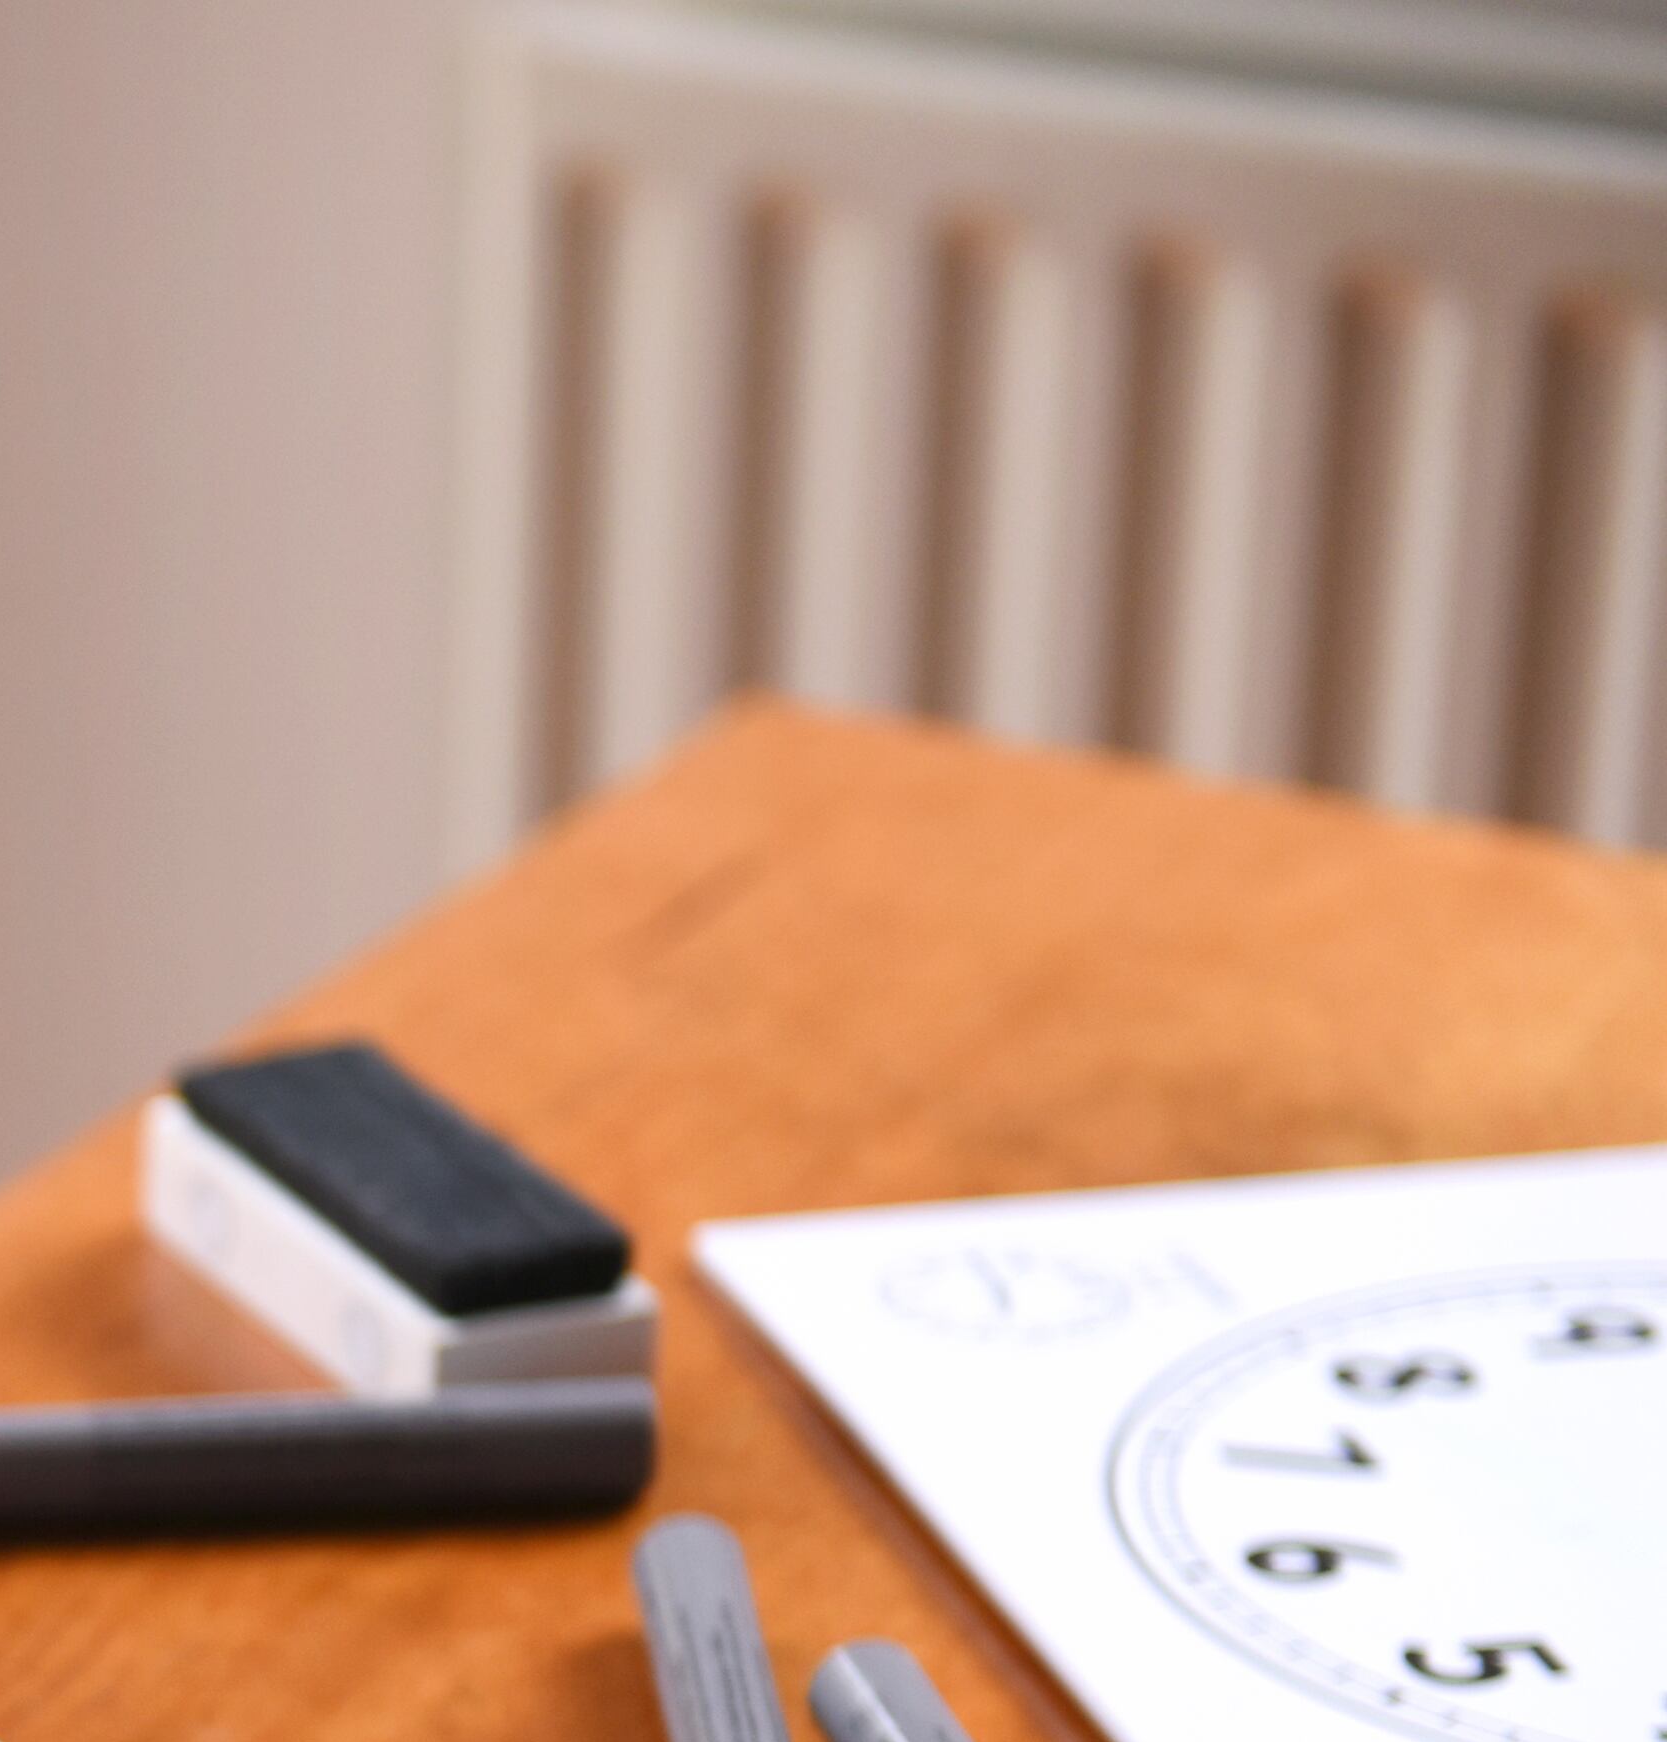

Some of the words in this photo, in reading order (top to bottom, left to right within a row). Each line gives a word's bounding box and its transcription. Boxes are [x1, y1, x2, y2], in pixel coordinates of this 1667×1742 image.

[1534, 1306, 1657, 1357] 9
[1331, 1352, 1478, 1403] 8
[1240, 1536, 1395, 1587] 6
[1402, 1637, 1569, 1687] 5
